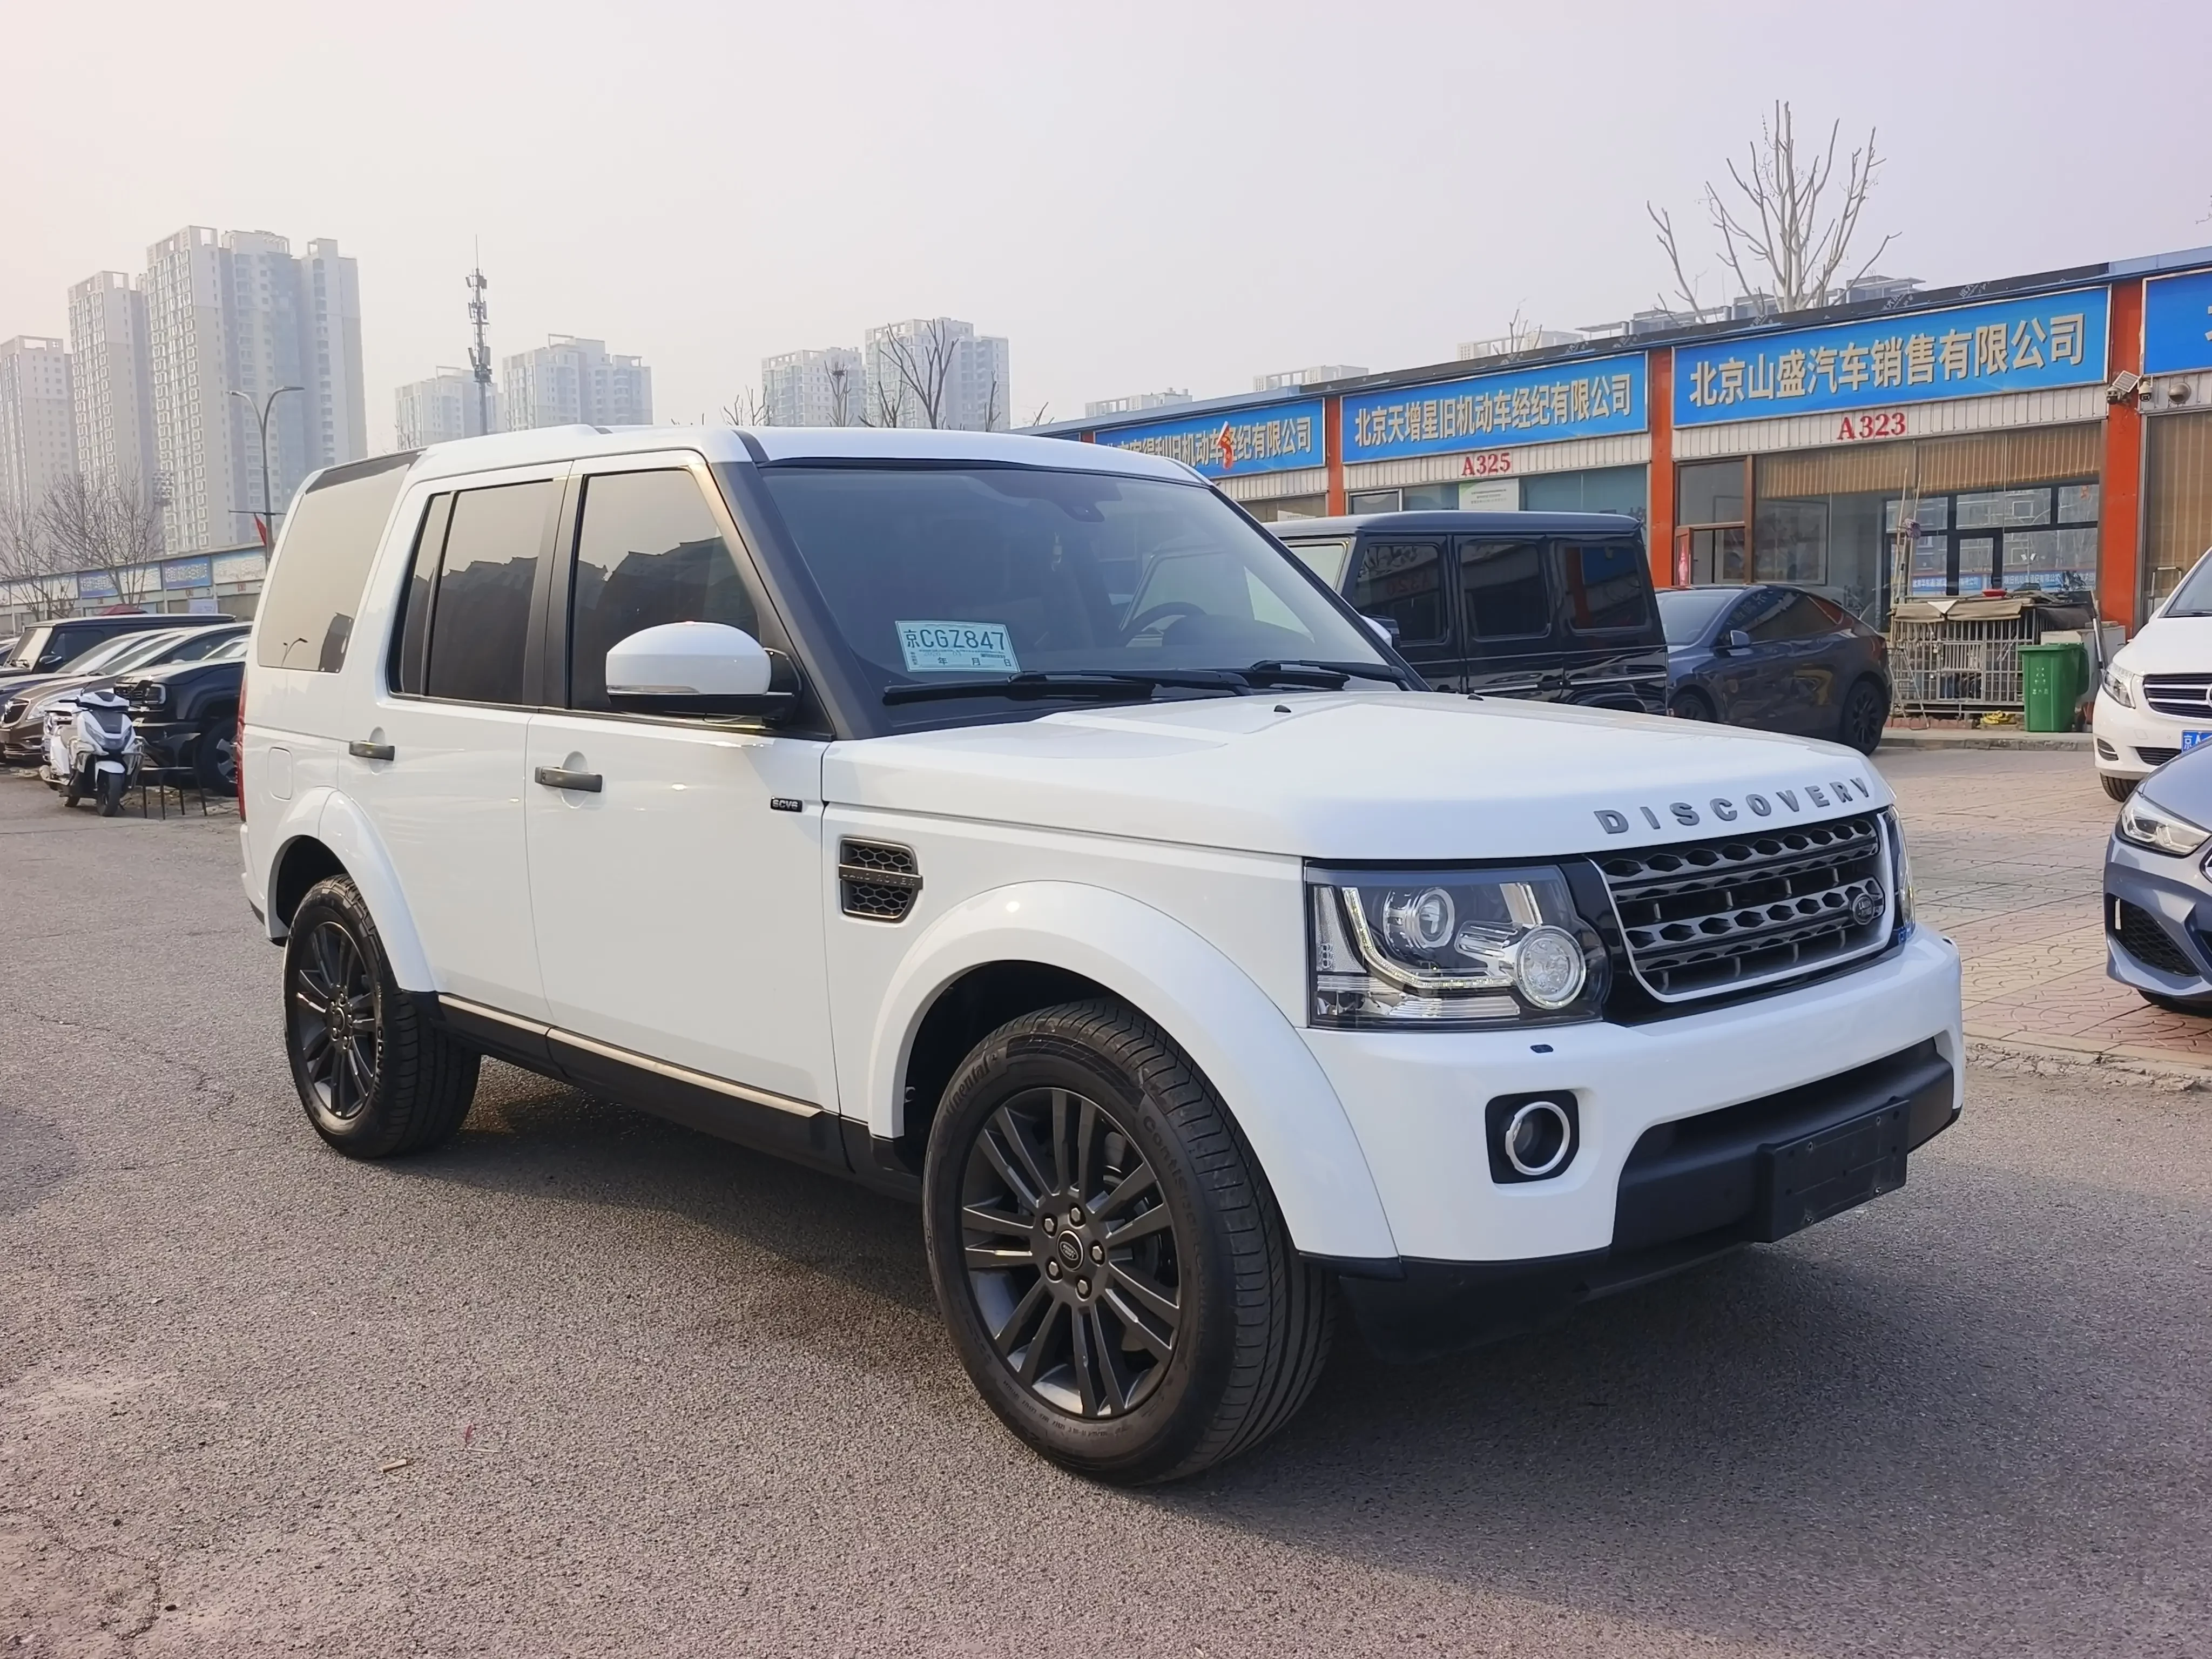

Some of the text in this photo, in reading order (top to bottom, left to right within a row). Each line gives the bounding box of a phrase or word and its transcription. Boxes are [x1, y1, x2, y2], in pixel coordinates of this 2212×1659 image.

[1688, 313, 2086, 408] 北京山盛汽车销售有限公司
[1354, 373, 1631, 447] 北京天增星旧机动车经纪有限公司
[1837, 413, 1907, 440] A323
[1461, 452, 1511, 476] A325
[903, 629, 1004, 650] 京CGZ847
[938, 657, 948, 665] 年
[1594, 777, 1870, 834] DISCOVERY
